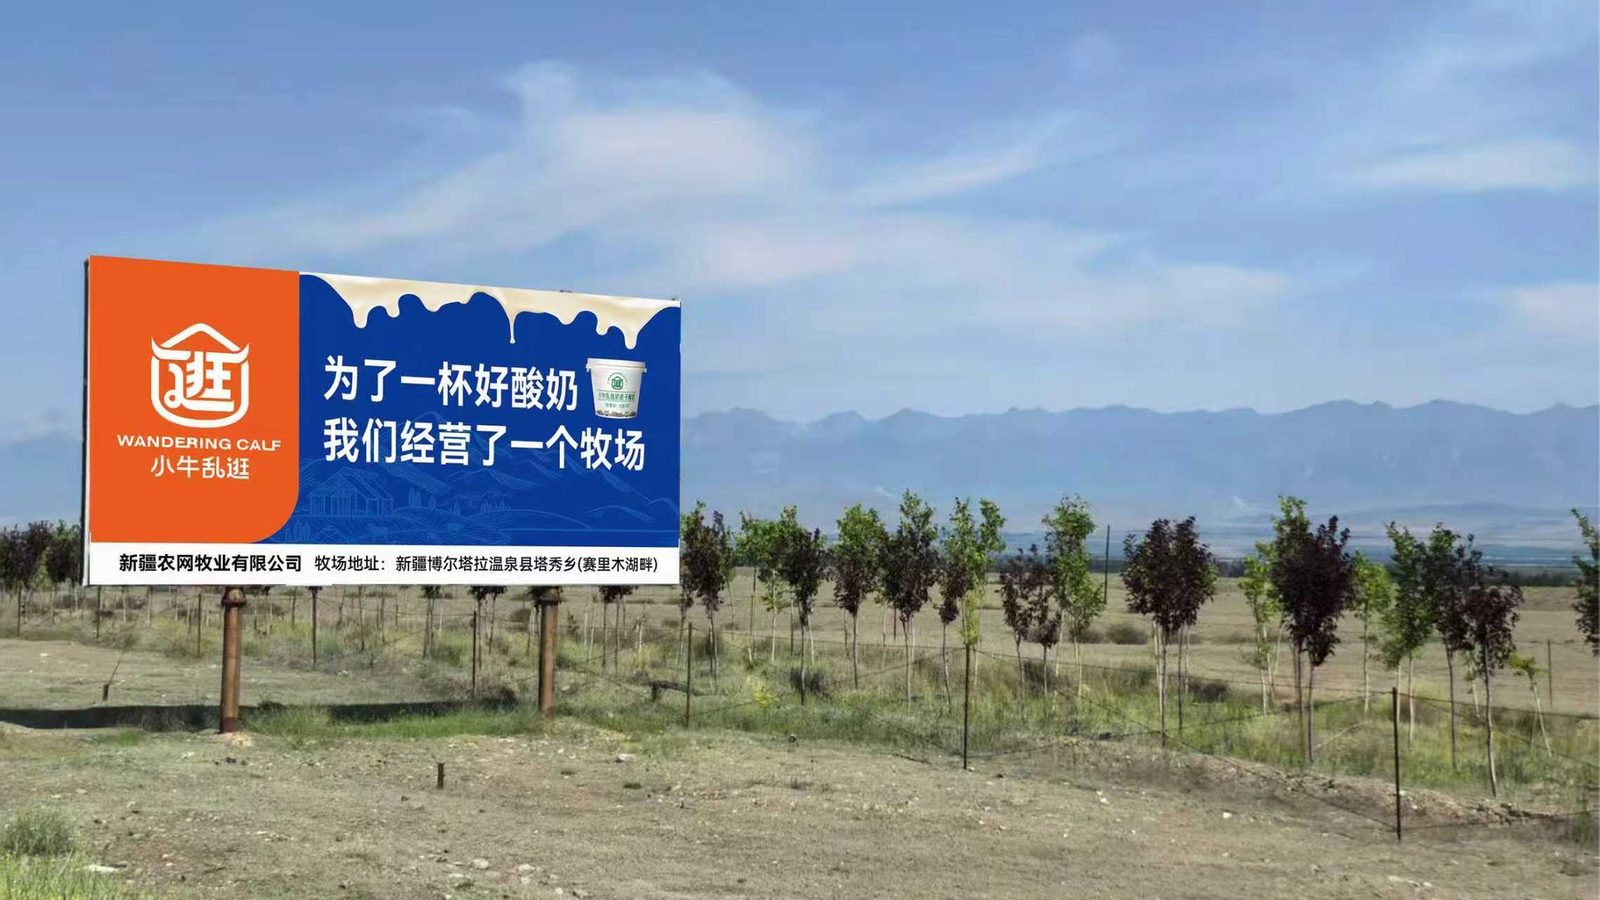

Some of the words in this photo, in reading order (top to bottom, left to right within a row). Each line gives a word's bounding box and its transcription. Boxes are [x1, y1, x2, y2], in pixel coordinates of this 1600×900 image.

[324, 355, 578, 411] 为了一杯好酸奶
[117, 434, 231, 451] WANDERING
[236, 438, 281, 452] CALF
[324, 417, 645, 471] 我们经营了一个牧场
[150, 455, 250, 480] 小牛乱逛
[119, 554, 302, 573] 新疆农网牧业有限公司
